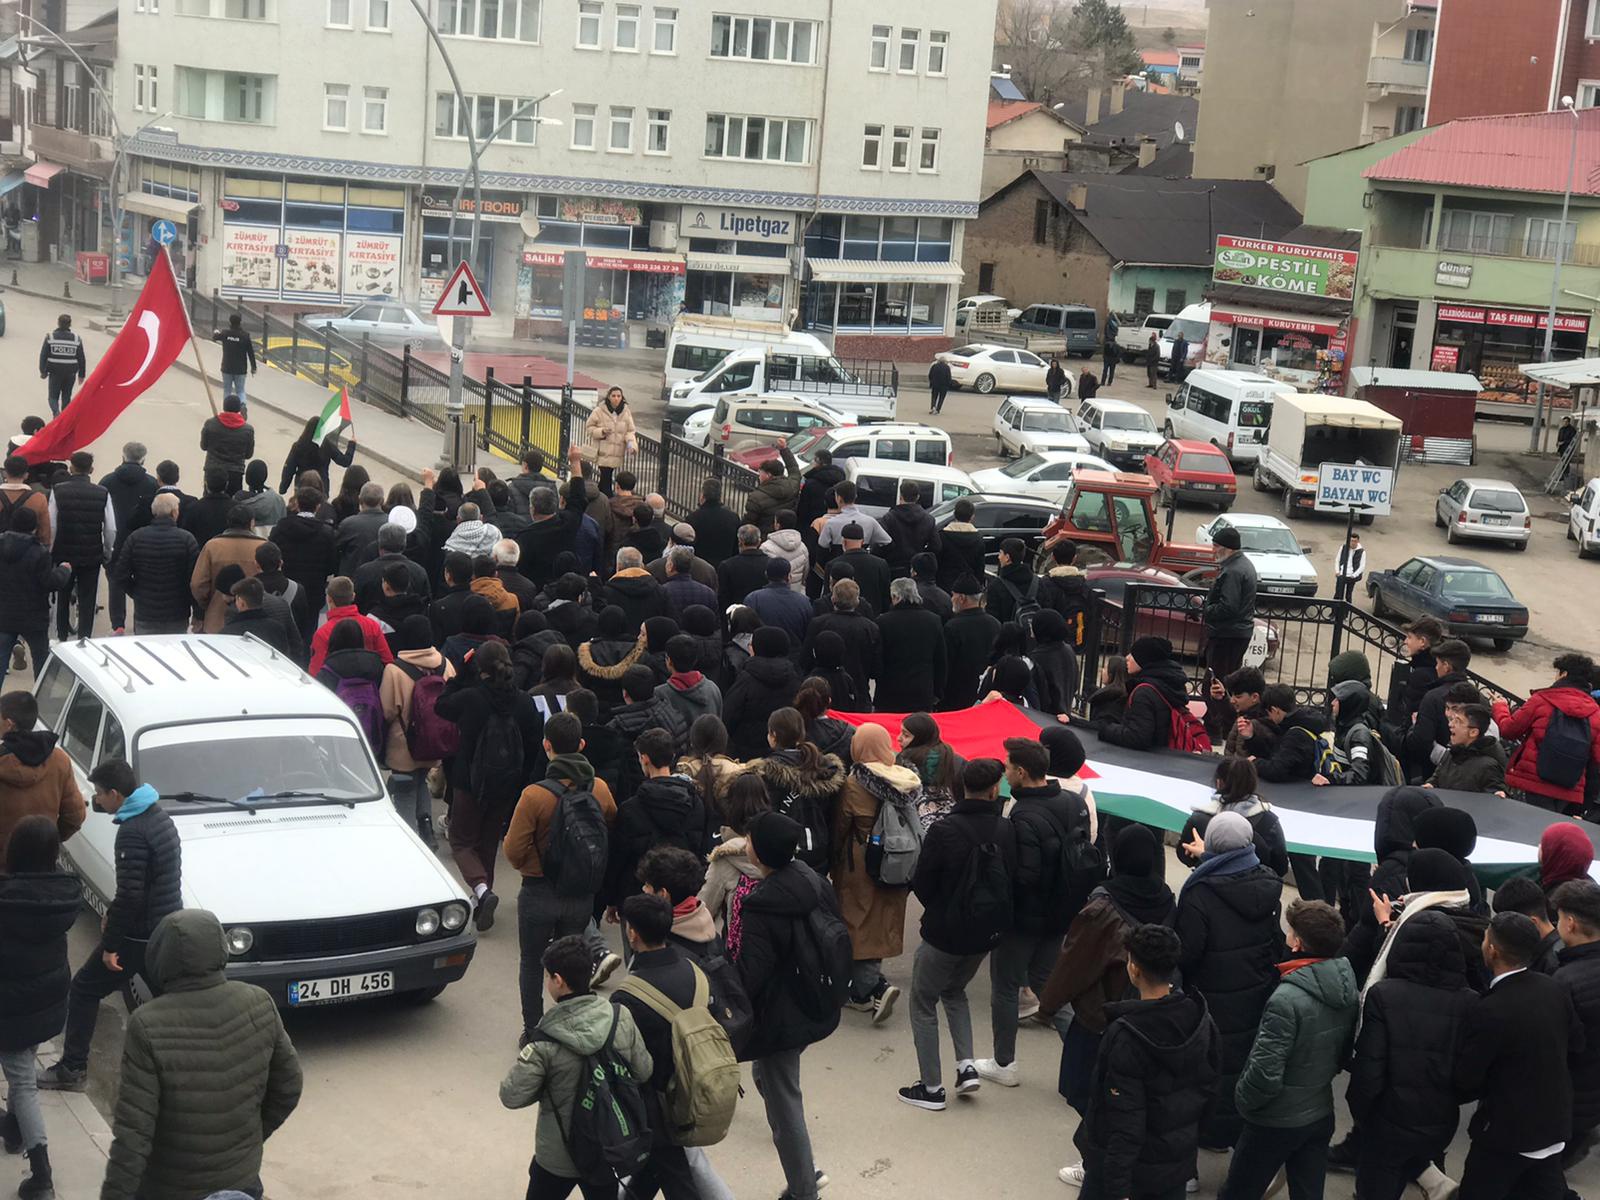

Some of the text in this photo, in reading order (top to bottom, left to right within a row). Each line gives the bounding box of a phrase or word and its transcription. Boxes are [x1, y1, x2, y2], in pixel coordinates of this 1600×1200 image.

[720, 212, 790, 238] Lipetgaz
[234, 231, 267, 242] ZÜMRÜT
[295, 236, 328, 247] ZÜMRÜT
[356, 240, 390, 250] ZÜMRÜT
[525, 252, 555, 264] SALİH
[1277, 245, 1344, 262] KURUYEMİŞ
[1257, 256, 1321, 276] PESTİL
[1257, 273, 1317, 294] KÖME
[1489, 312, 1534, 324] TAŞ FIRIN
[1539, 316, 1586, 328] EKEK FIRINI
[1268, 319, 1316, 333] KURUYEMİŞ
[1332, 468, 1381, 484] BAY WC
[1322, 486, 1387, 503] BAYAN WC
[300, 982, 320, 999] 24
[330, 978, 351, 996] DH
[361, 972, 390, 991] 456
